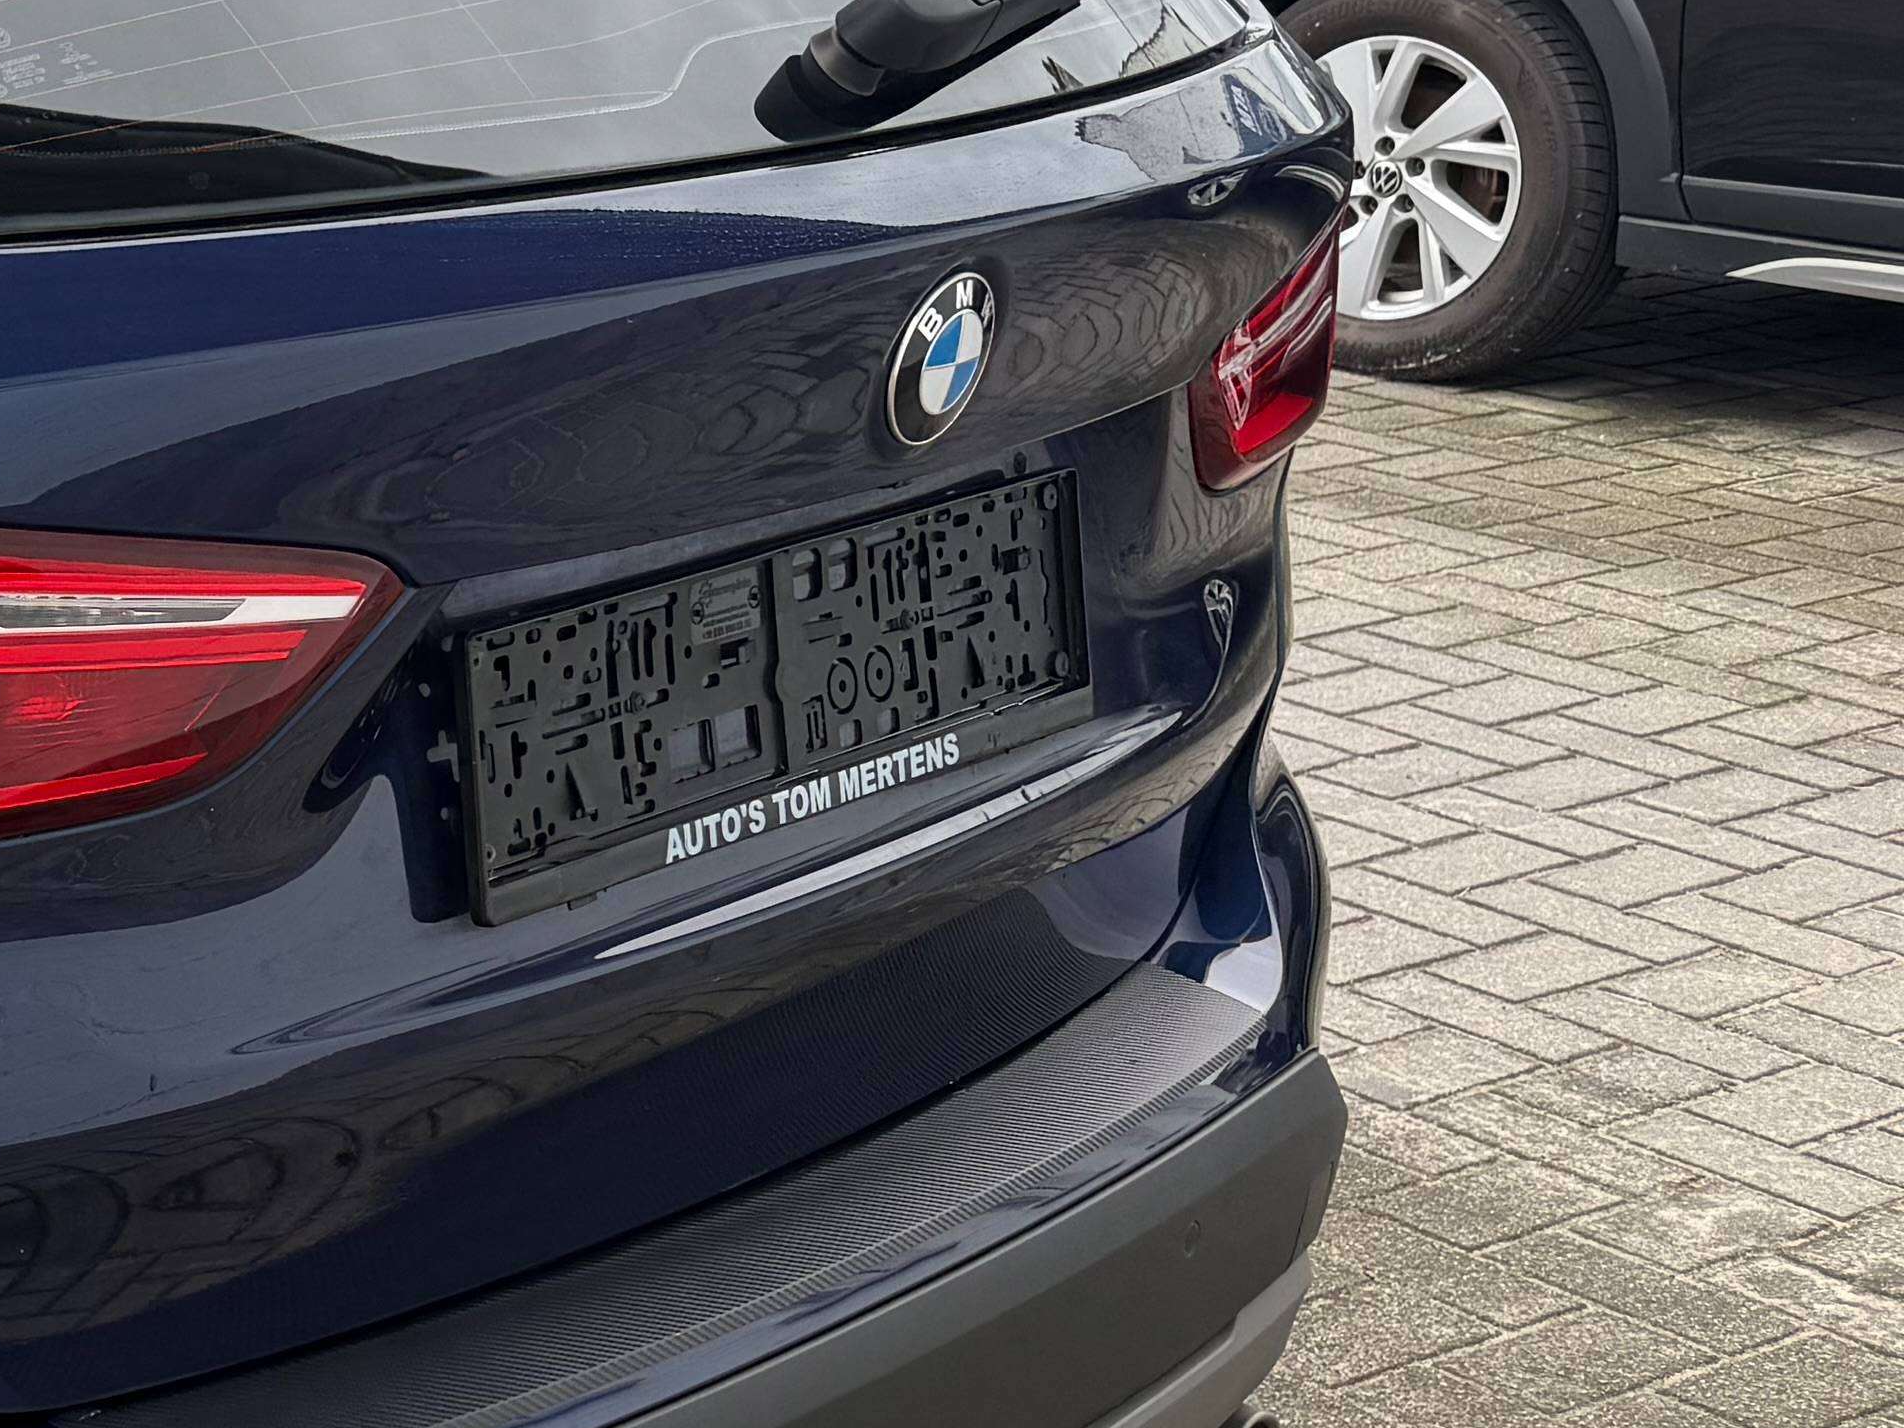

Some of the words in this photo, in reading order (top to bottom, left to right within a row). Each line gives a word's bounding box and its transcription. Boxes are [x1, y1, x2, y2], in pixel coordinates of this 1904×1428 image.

[665, 799, 766, 864] AUTO'S
[772, 777, 832, 825] TOM
[838, 733, 960, 804] MERTENS
